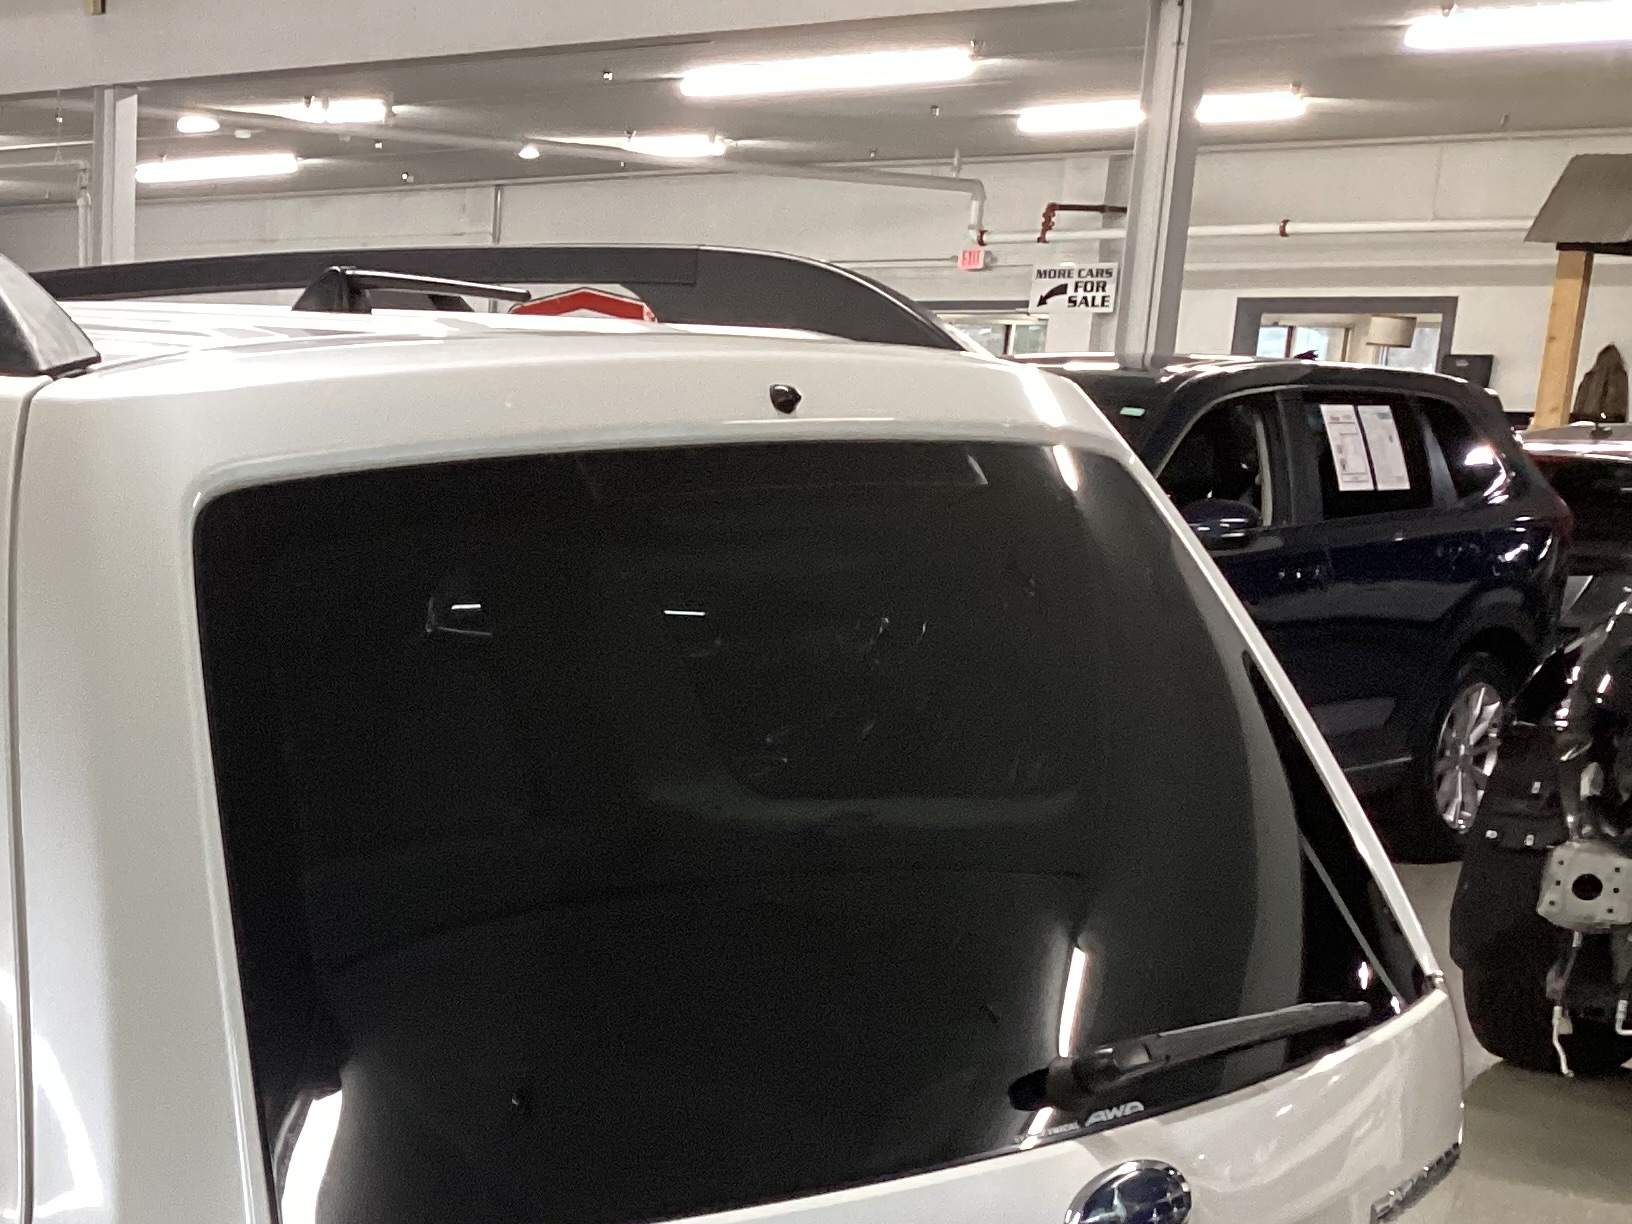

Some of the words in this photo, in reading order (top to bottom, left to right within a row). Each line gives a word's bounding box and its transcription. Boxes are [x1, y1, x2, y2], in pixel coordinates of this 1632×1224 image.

[962, 250, 981, 265] EXIT
[1036, 269, 1074, 280] MORE
[1078, 268, 1114, 279] CARS
[1074, 281, 1107, 293] FOR
[1068, 296, 1110, 308] SALE
[1085, 1101, 1145, 1127] AWD
